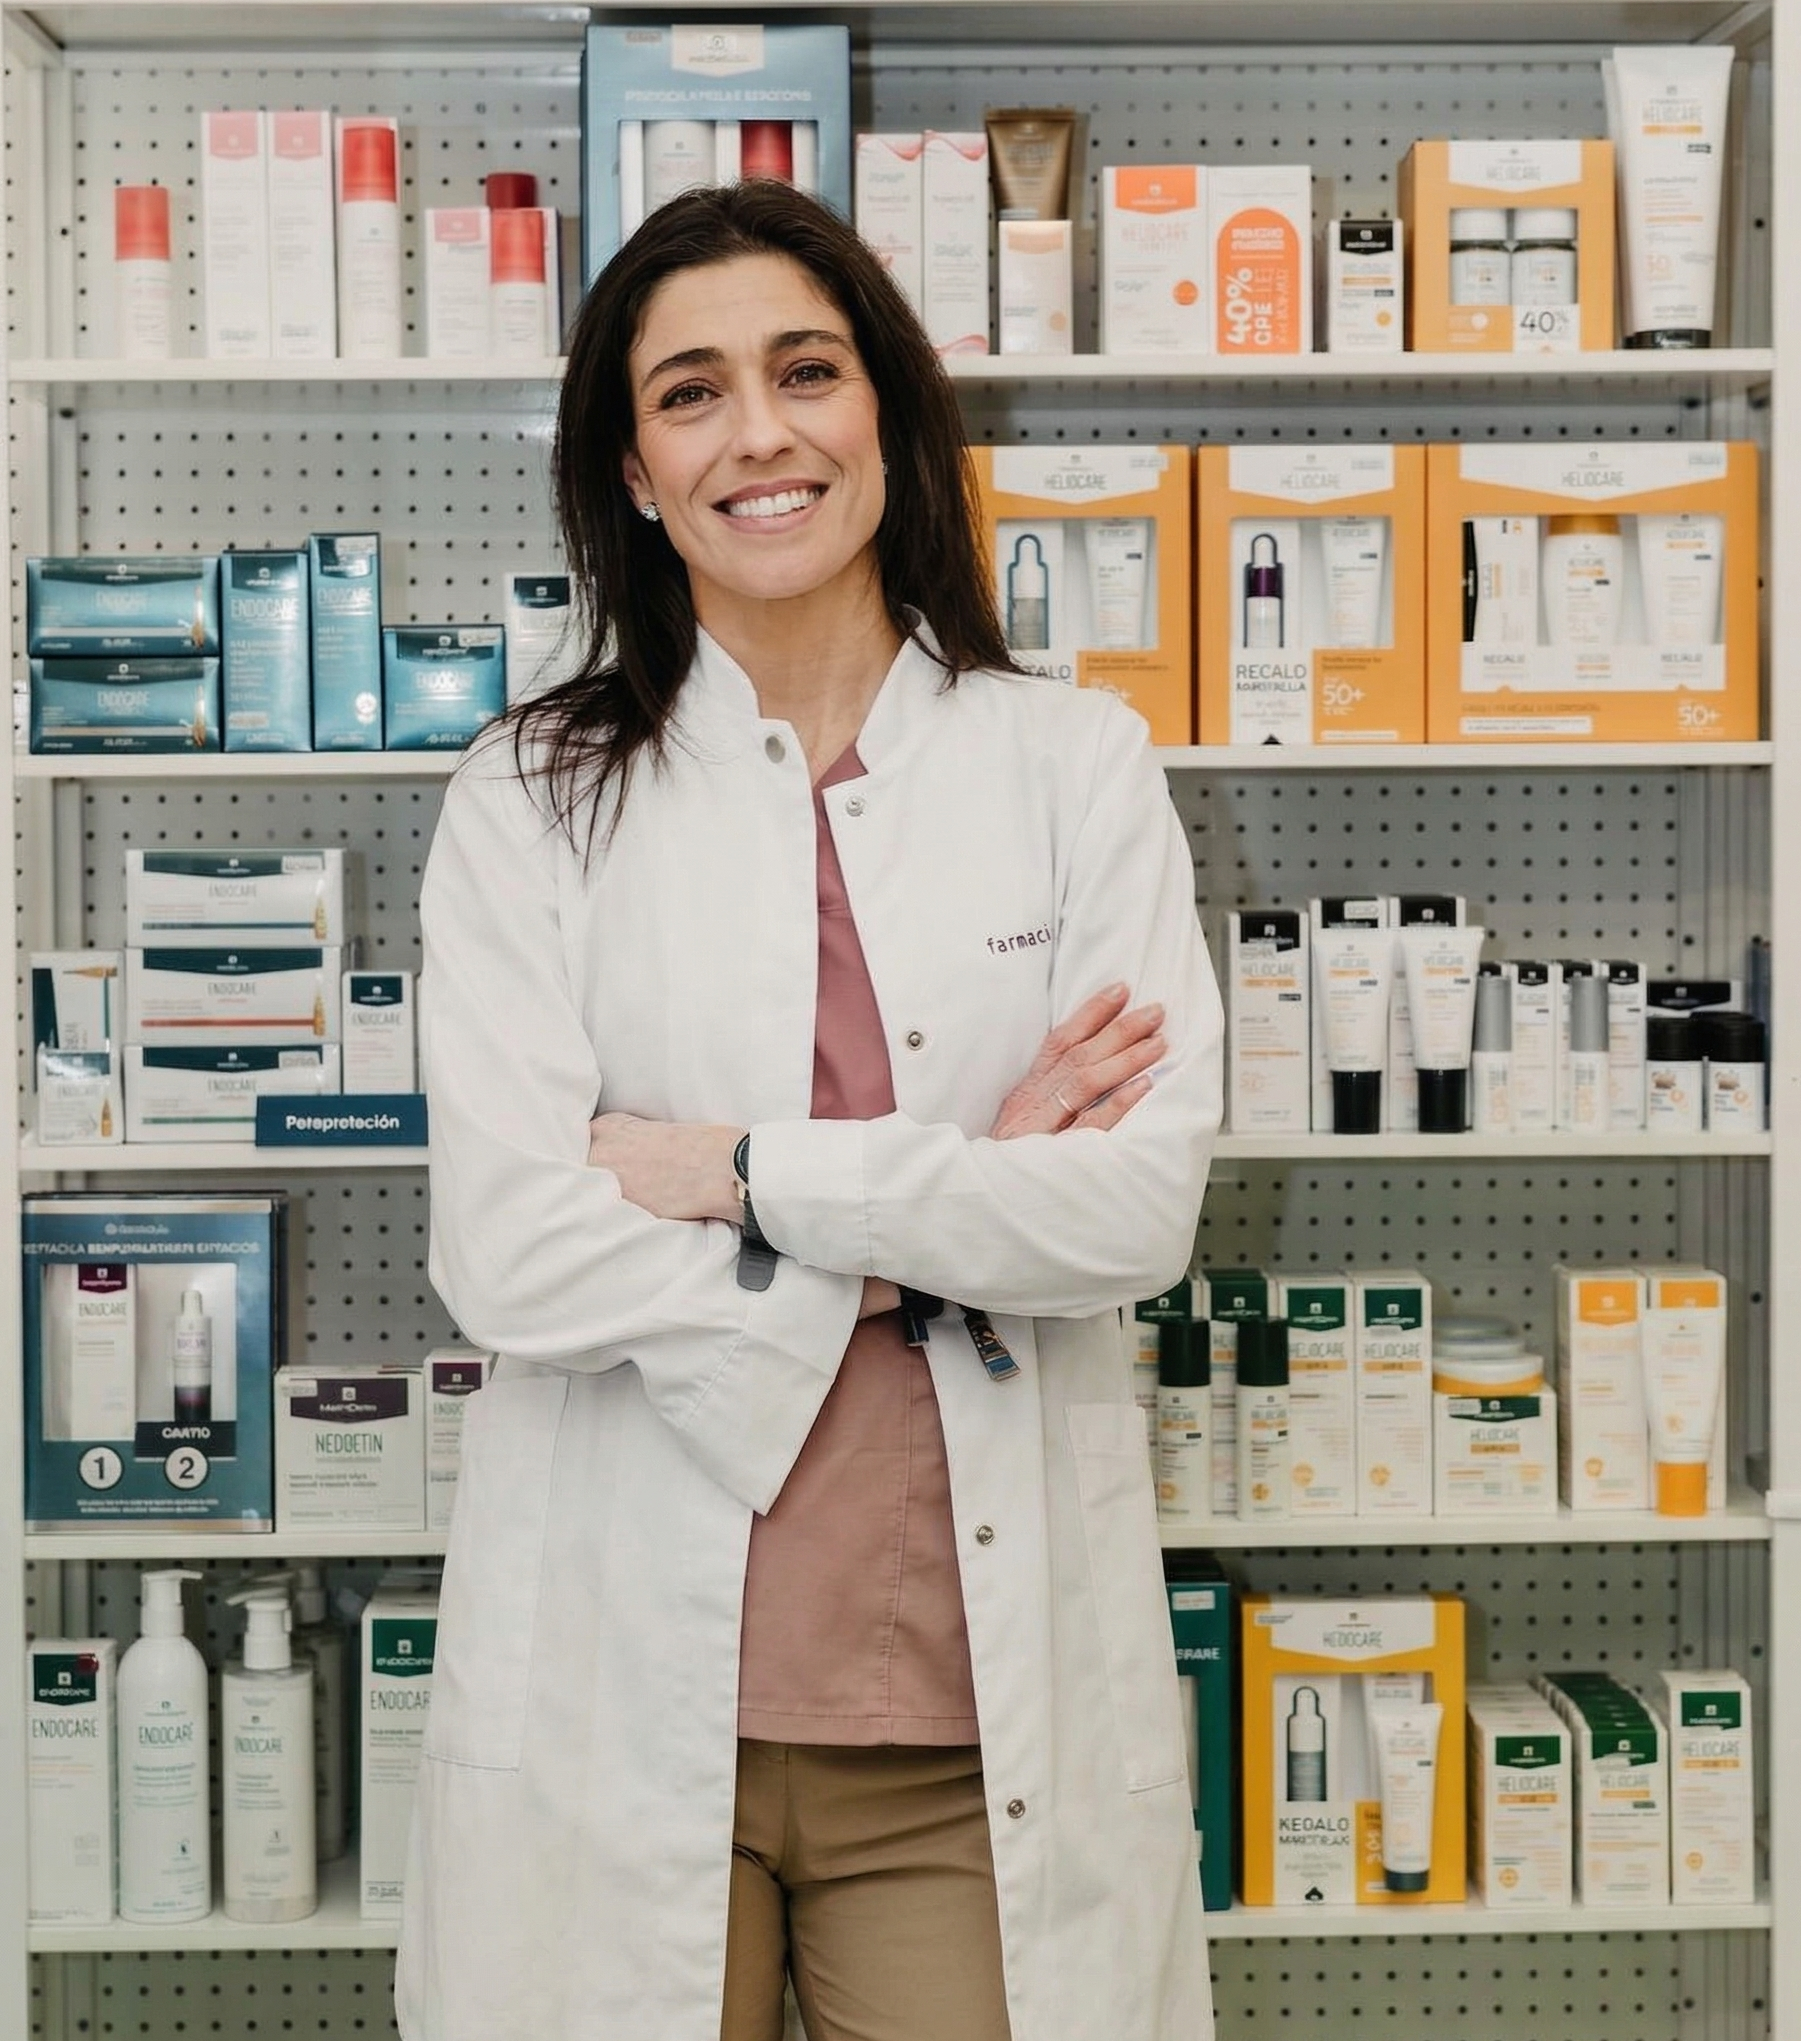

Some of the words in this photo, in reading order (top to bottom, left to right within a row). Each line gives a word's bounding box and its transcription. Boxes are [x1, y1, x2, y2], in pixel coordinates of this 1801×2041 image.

[1225, 267, 1253, 345] 40%
[1323, 686, 1365, 706] 50+
[93, 1457, 105, 1480] 1
[179, 1457, 195, 1479] 2
[32, 1719, 99, 1738] ENDOCARE
